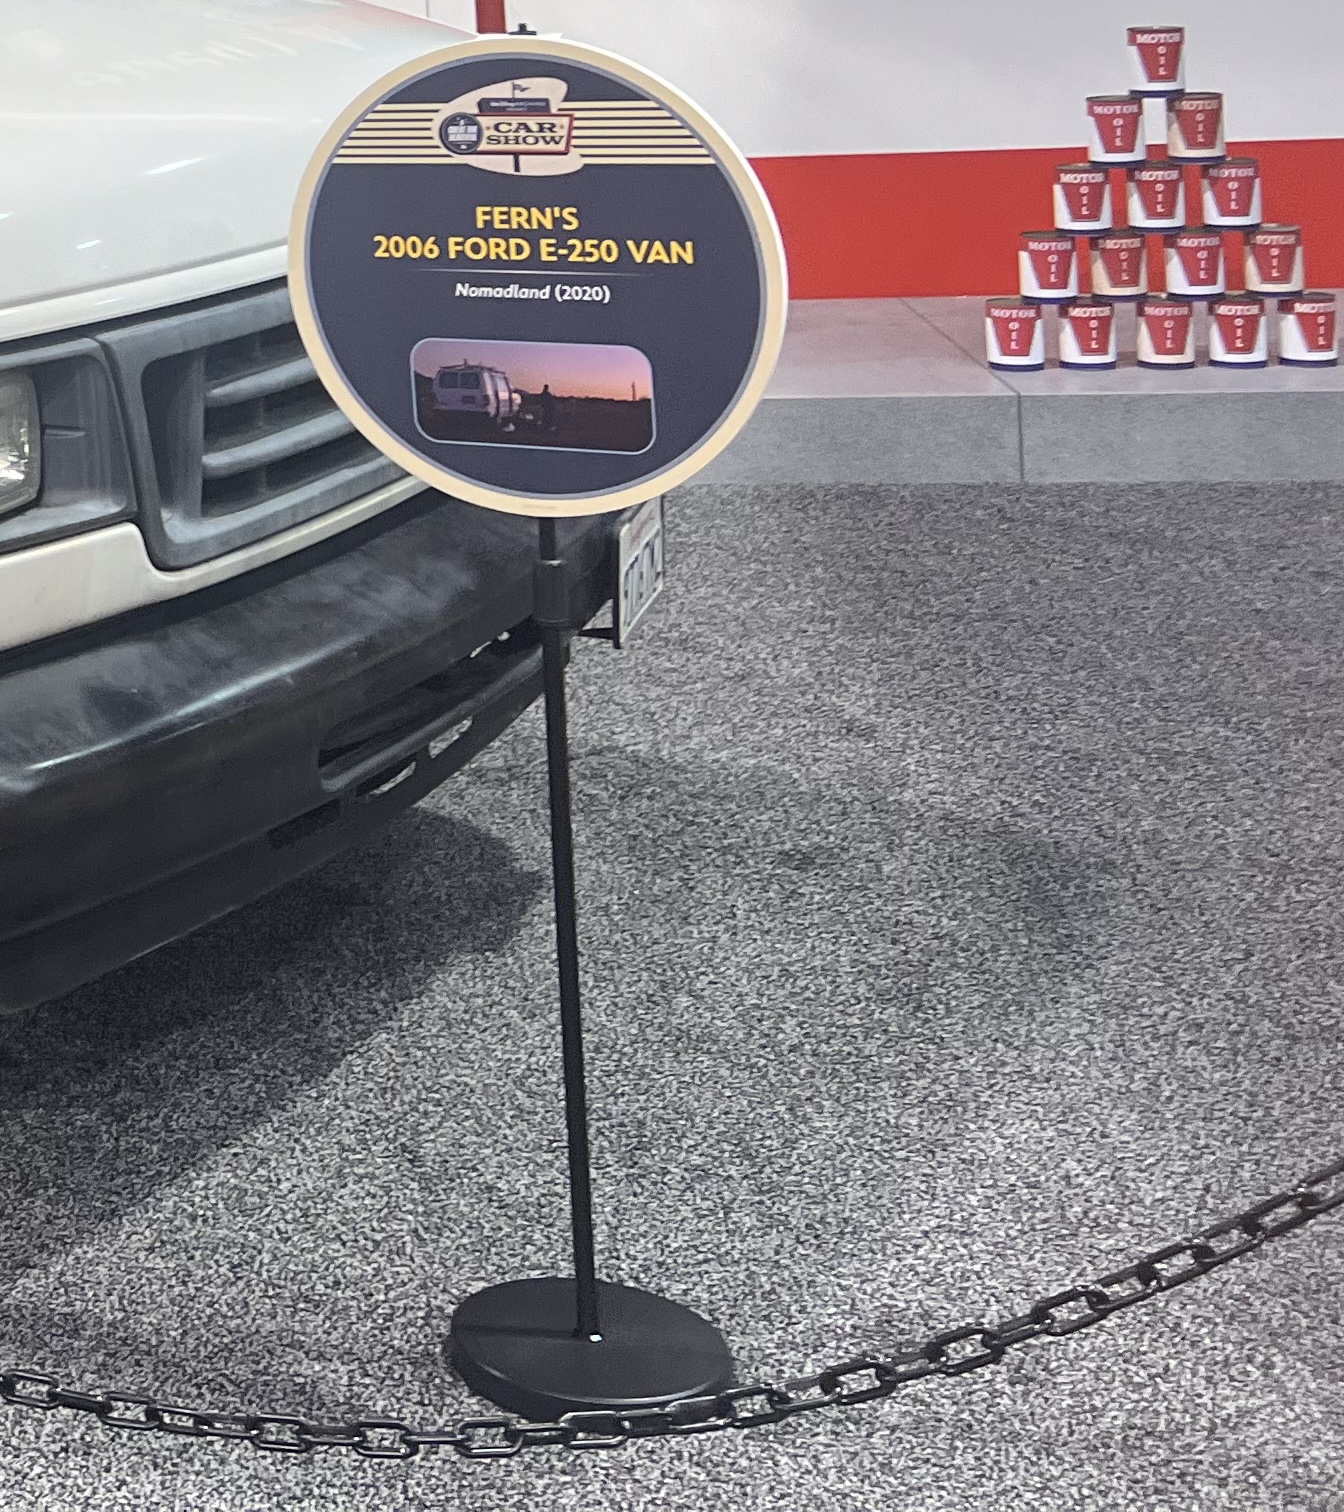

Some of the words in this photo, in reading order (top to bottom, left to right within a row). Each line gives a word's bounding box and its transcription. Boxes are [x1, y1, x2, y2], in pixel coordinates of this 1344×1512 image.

[1135, 32, 1182, 45] MOTOR
[1157, 45, 1168, 75] OIL
[1093, 105, 1139, 114] MOTOR
[1175, 100, 1220, 110] MOTOR
[493, 122, 558, 134] CAR
[1113, 118, 1124, 146] OIL
[1195, 112, 1205, 142] OIL
[486, 134, 565, 146] SHOW
[1059, 172, 1105, 183] MOTOR
[1135, 169, 1180, 181] MOTOR
[1208, 167, 1255, 178] MOTOR
[1079, 186, 1090, 215] OIL
[1155, 183, 1165, 213] OIL
[1228, 181, 1239, 210] OIL
[475, 205, 580, 231] FERN'S
[373, 235, 440, 260] 2006
[448, 236, 531, 262] FORD
[540, 238, 620, 263] E-250
[626, 240, 695, 265] VAN
[1028, 241, 1072, 251] MOTOR
[1098, 238, 1141, 249] MOTOR
[1177, 236, 1220, 247] MOTOR
[1250, 235, 1296, 245] MOTOR
[1047, 254, 1058, 283] OIL
[1119, 251, 1129, 280] OIL
[1196, 250, 1208, 279] OIL
[1269, 247, 1280, 277] OIL
[454, 283, 550, 301] Nomadland
[554, 284, 611, 304] (2020)
[991, 308, 1036, 318] MOTOR
[1068, 306, 1112, 318] MOTOR
[1144, 306, 1189, 316] MOTOR
[1215, 304, 1261, 315] MOTOR
[1008, 321, 1020, 350] OIL
[1089, 319, 1100, 349] OIL
[1164, 320, 1174, 348] OIL
[1234, 318, 1245, 348] OIL
